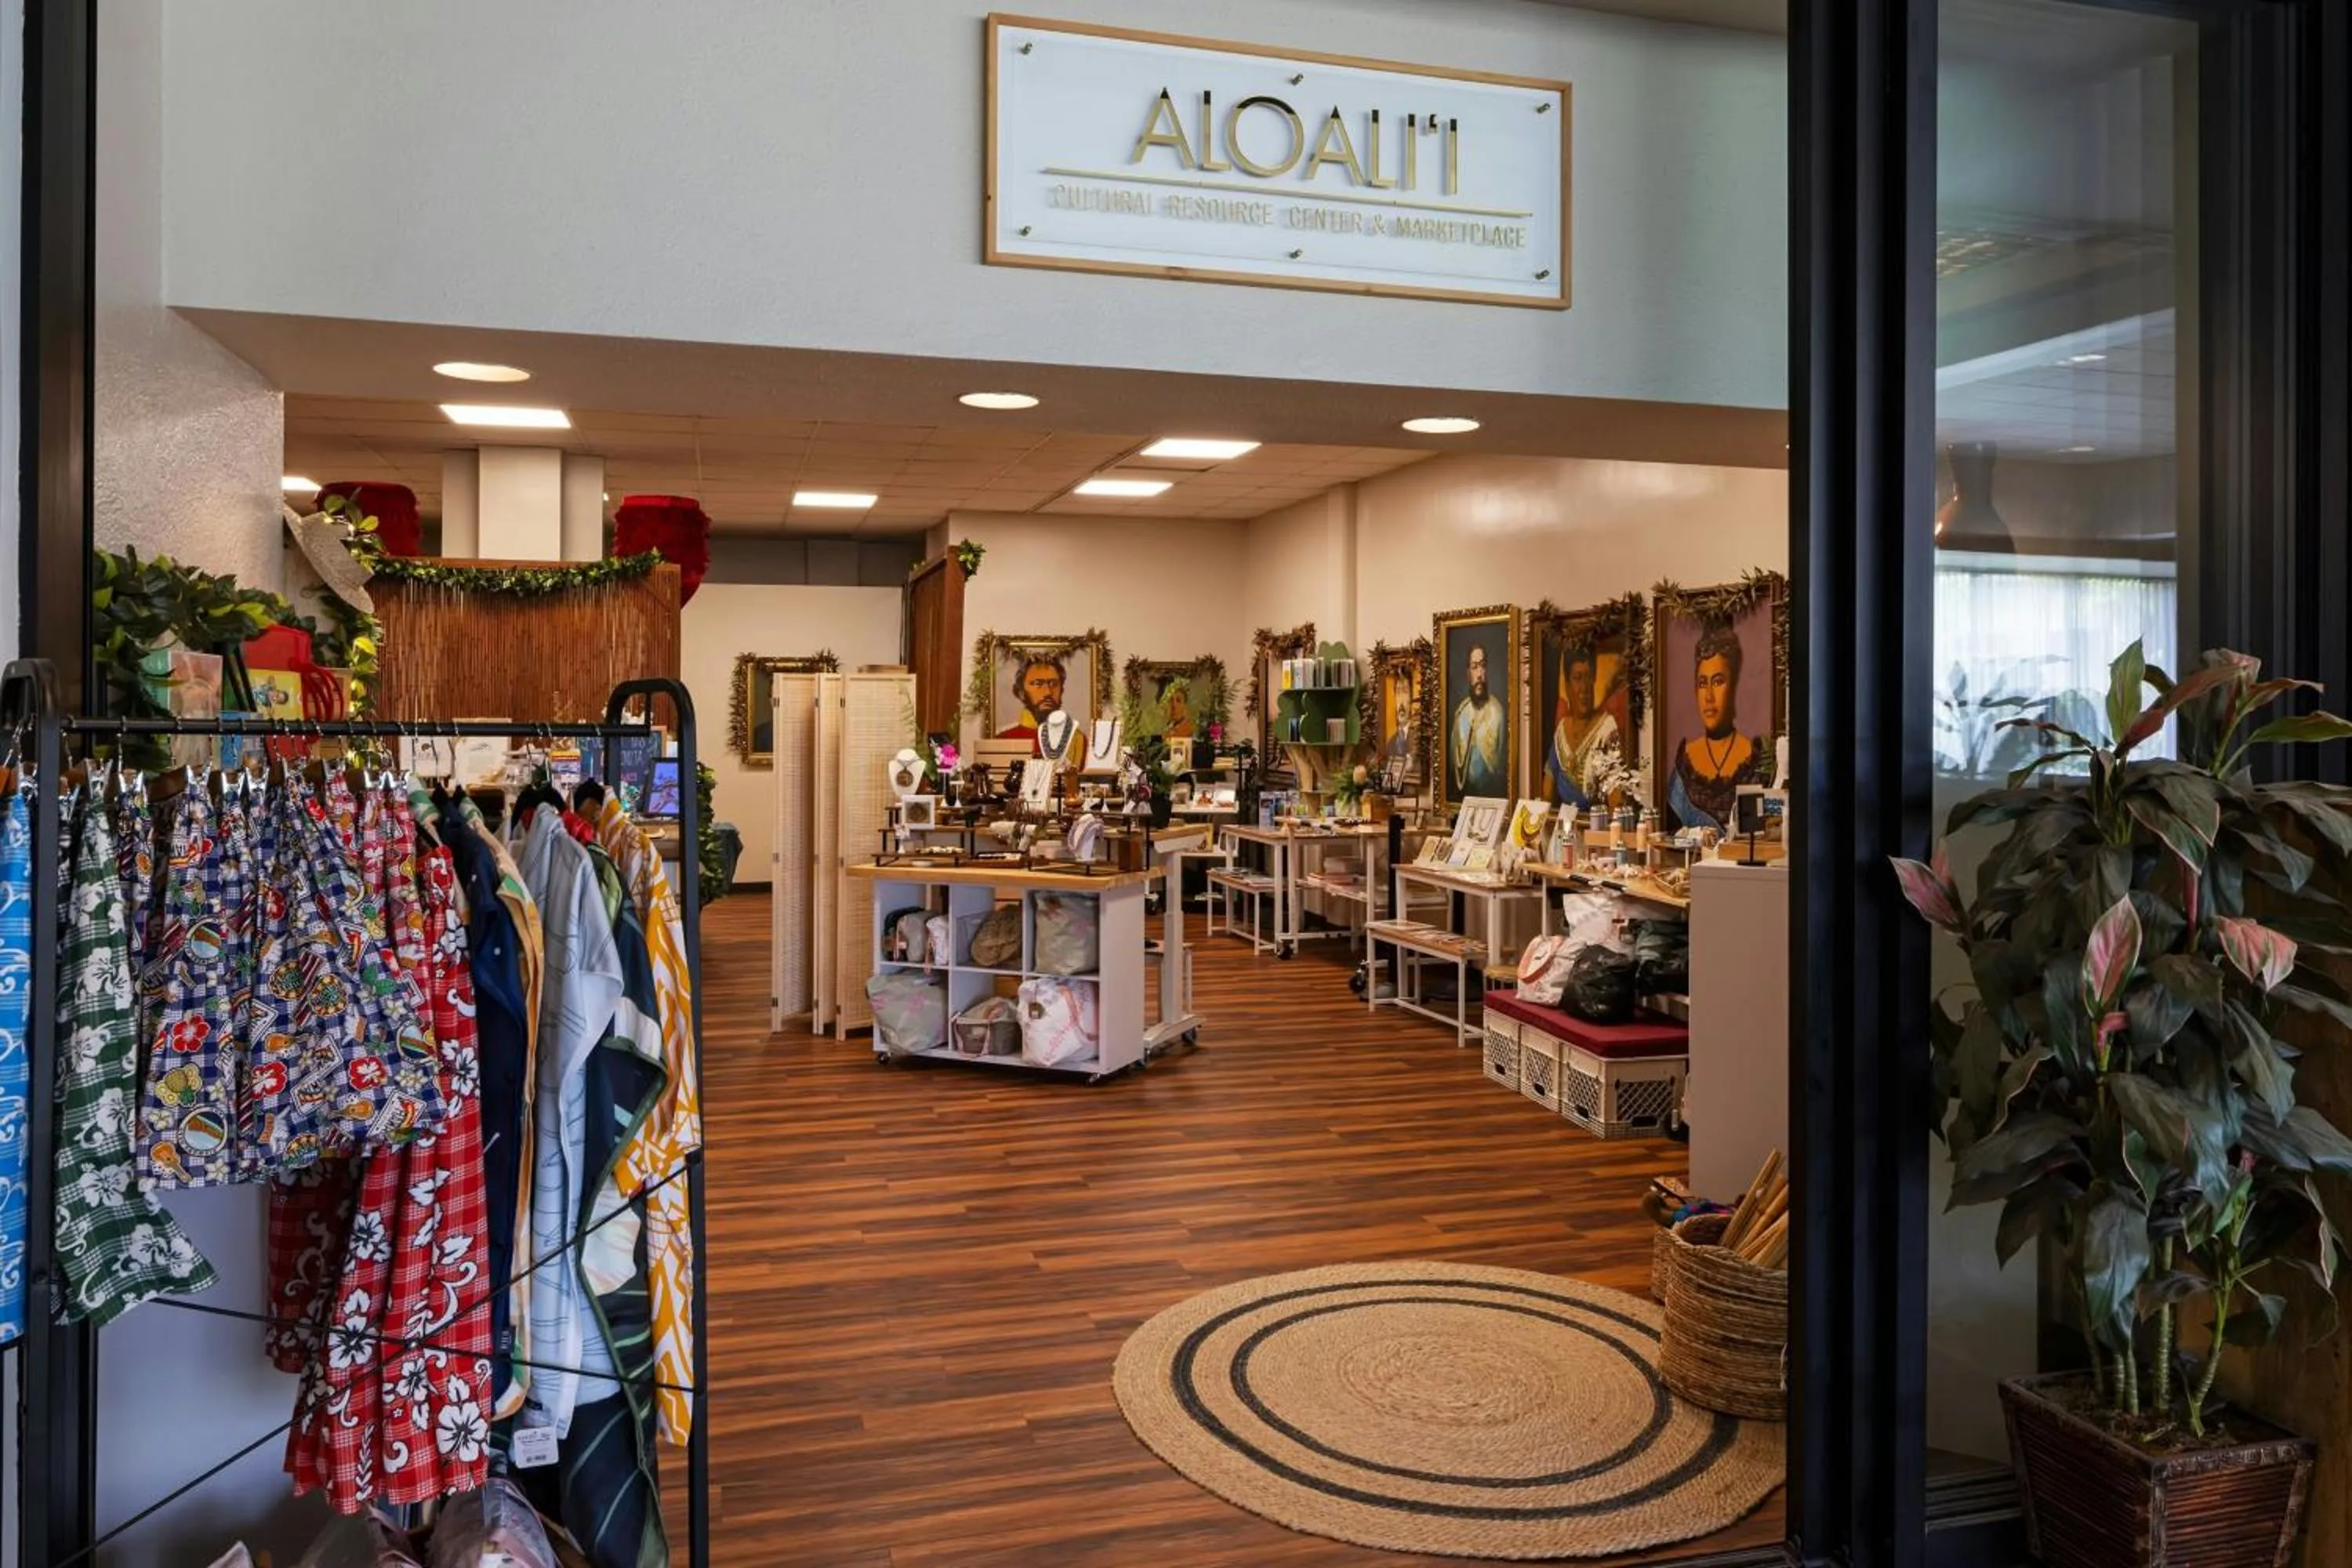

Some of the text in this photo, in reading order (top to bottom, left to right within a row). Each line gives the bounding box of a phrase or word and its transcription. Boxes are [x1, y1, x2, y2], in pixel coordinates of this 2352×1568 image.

[1051, 184, 1526, 248] CULTURAL RESOURCE CENTER & MARKETPLACE
